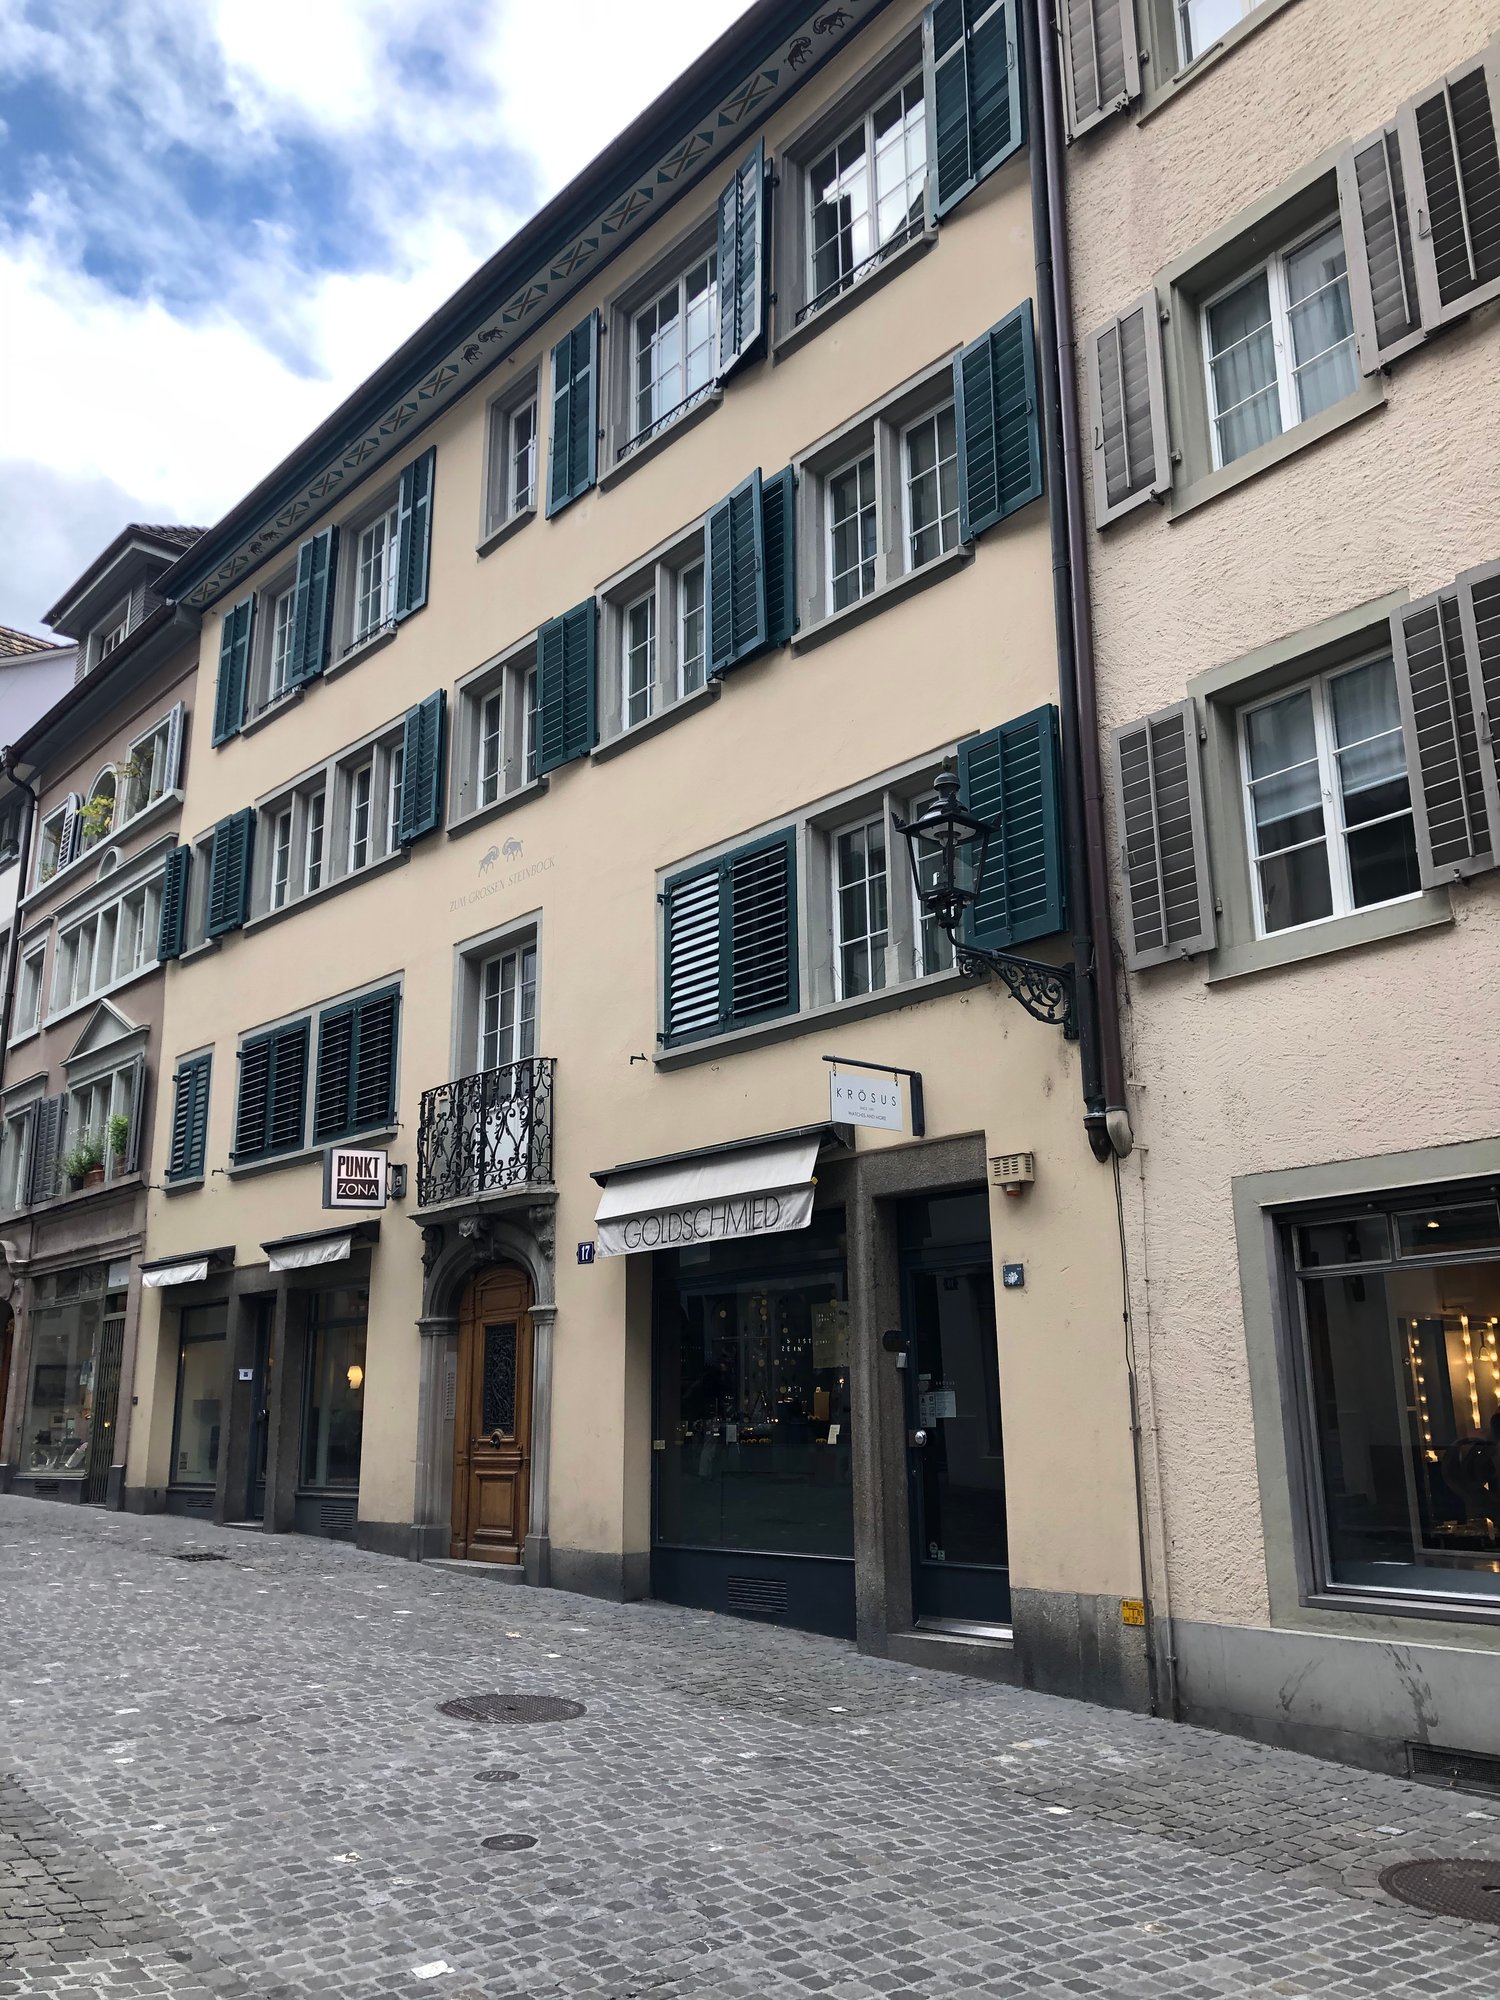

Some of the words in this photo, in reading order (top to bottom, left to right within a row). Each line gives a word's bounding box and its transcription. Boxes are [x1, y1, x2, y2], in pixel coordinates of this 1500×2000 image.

[449, 896, 466, 912] ZUM
[468, 880, 504, 904] GROSSEN
[508, 856, 555, 887] STEINBOCK
[836, 1088, 897, 1107] KRÖSUS
[337, 1155, 380, 1178] PUNKT
[338, 1183, 378, 1196] ZONA
[623, 1195, 780, 1249] GOLDSCHMIED
[581, 1245, 590, 1260] 17
